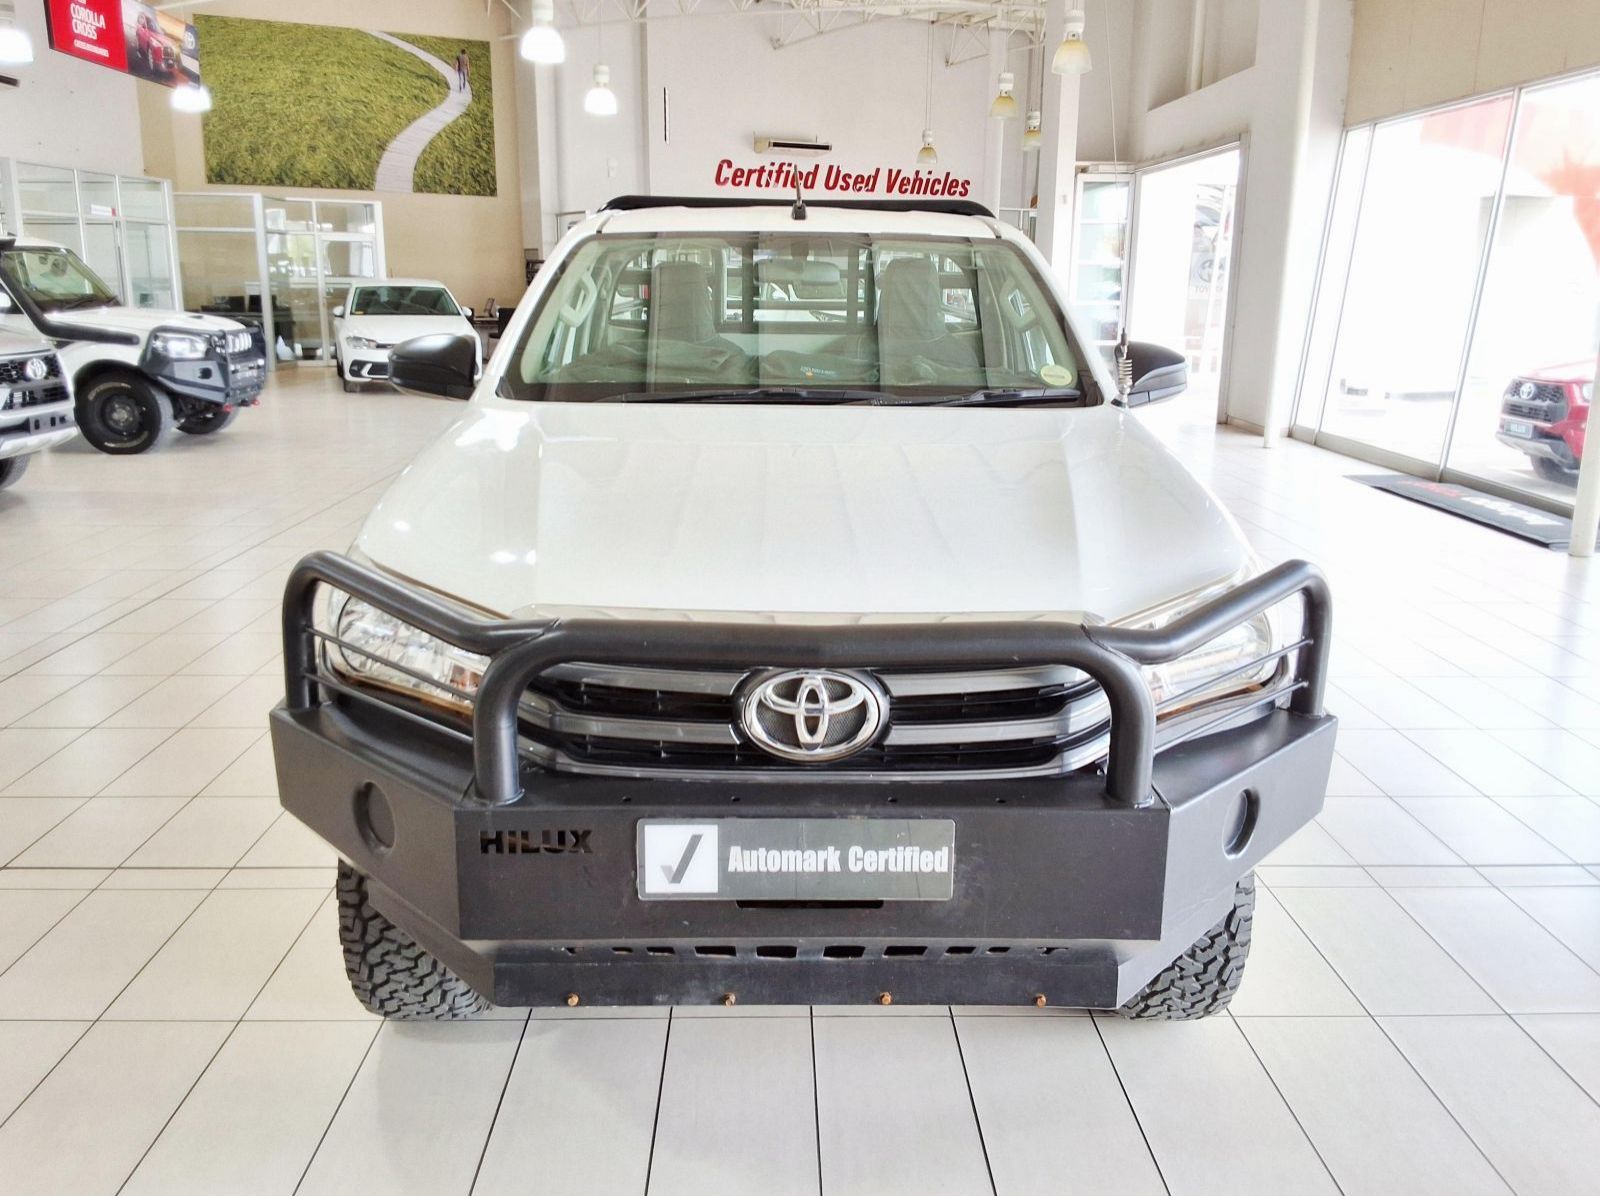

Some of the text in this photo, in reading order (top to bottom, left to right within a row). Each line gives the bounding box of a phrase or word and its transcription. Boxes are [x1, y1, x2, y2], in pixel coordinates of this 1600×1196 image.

[70, 3, 106, 29] COROLLA
[72, 19, 98, 40] CROSS
[715, 159, 971, 197] Certified Used Vehicles
[480, 830, 593, 854] HILUX
[728, 846, 949, 872] Automark Certified
